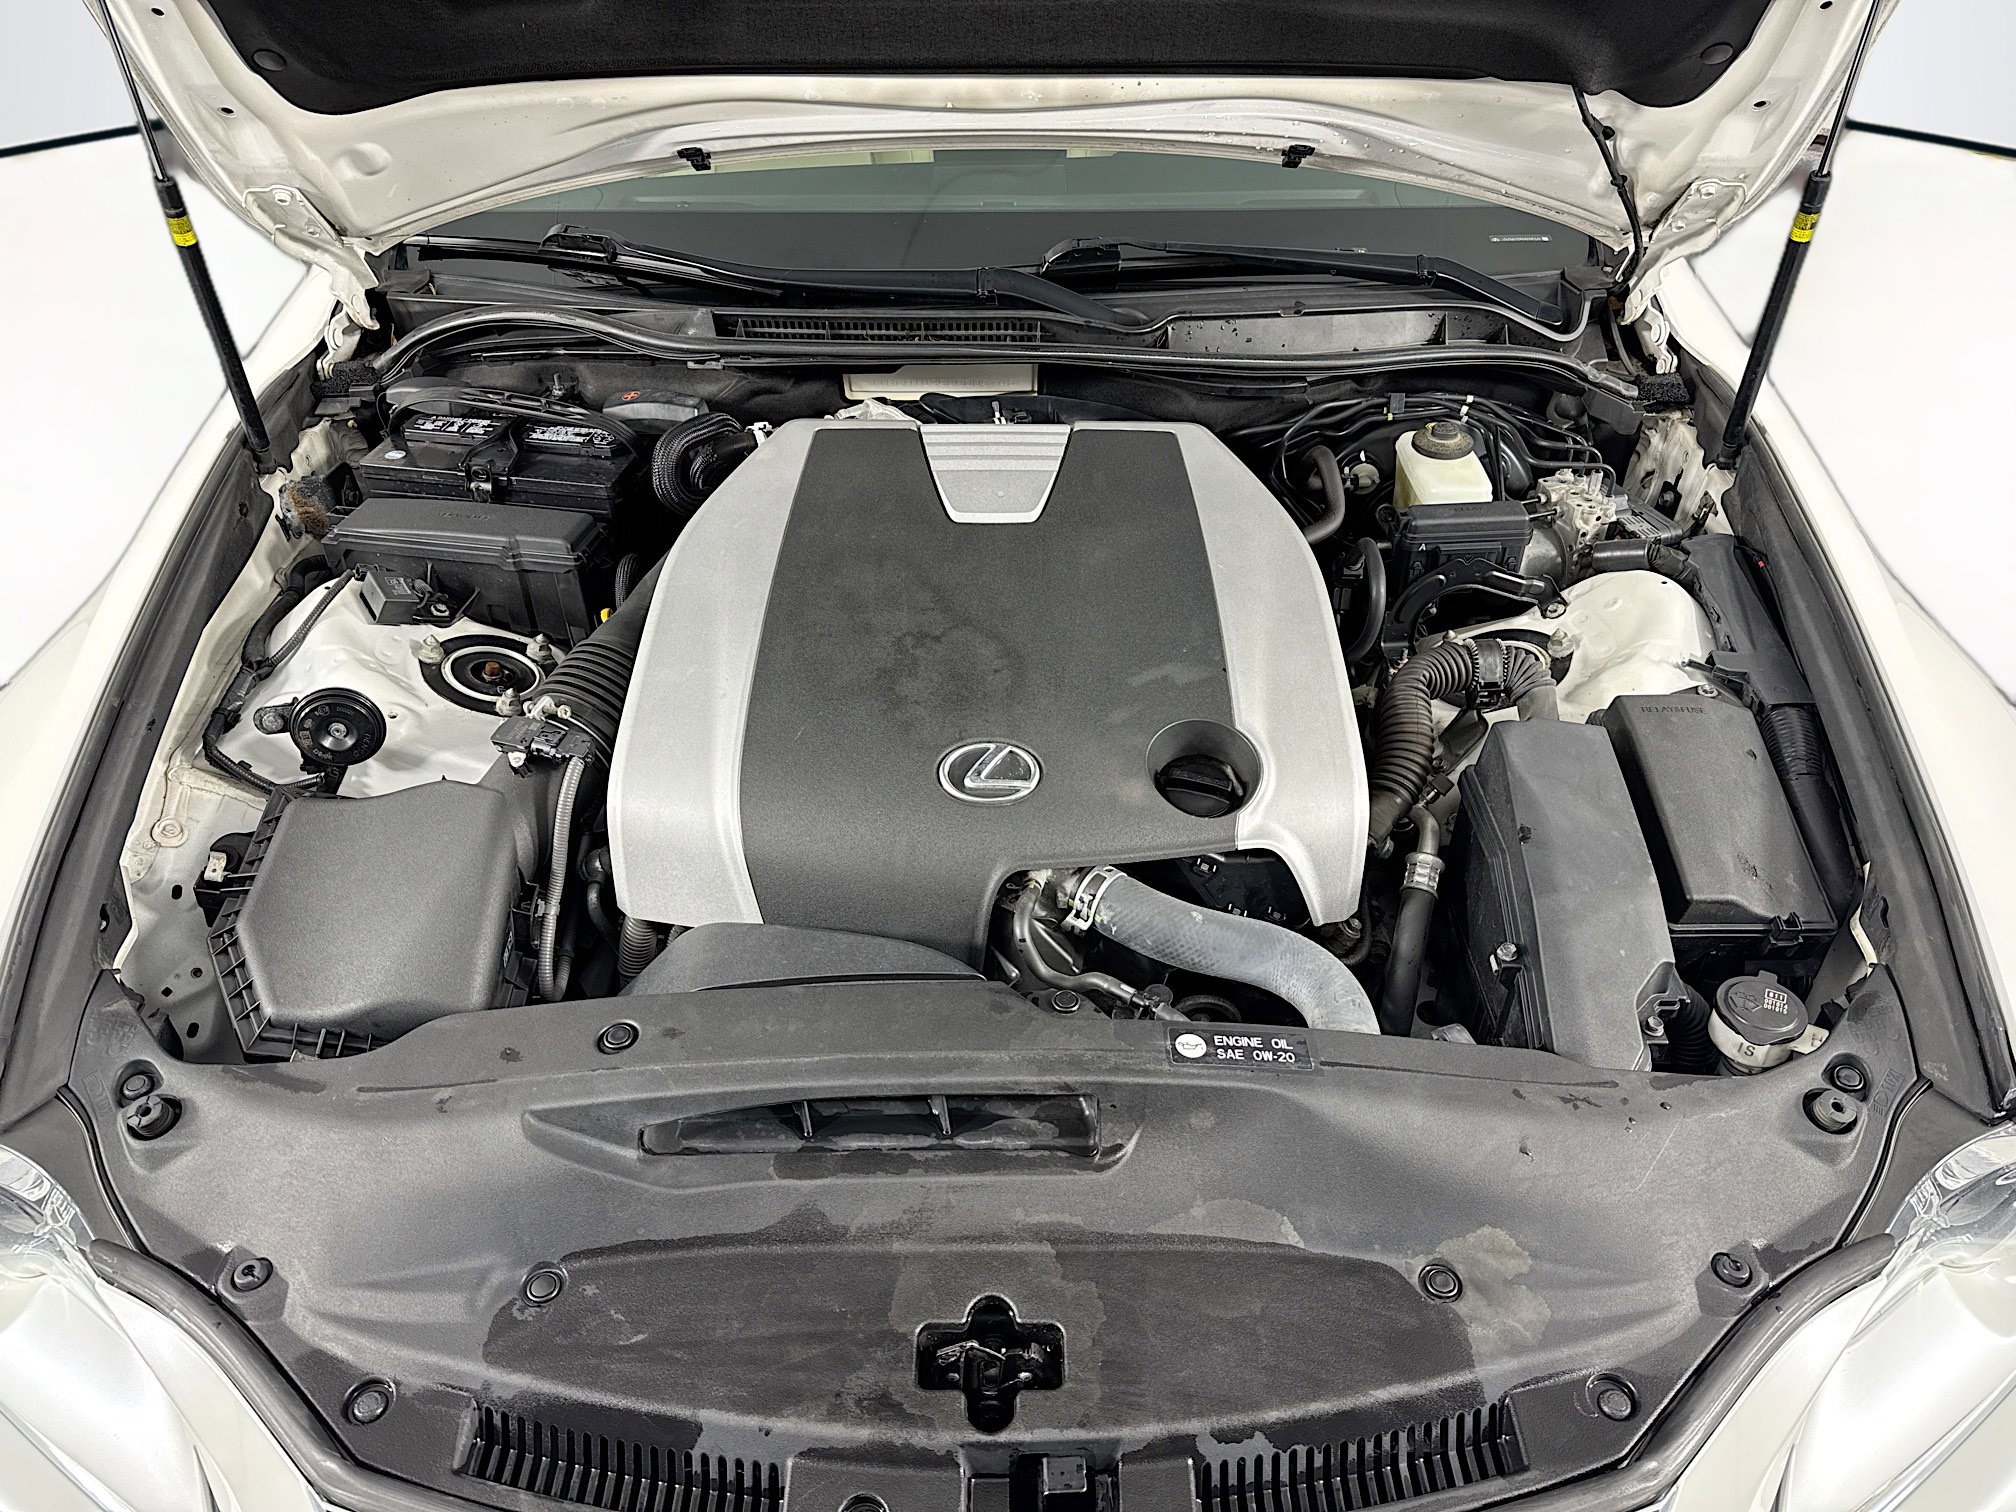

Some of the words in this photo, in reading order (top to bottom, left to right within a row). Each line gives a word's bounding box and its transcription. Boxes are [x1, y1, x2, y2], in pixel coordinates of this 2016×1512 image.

[1213, 1035, 1264, 1048] ENGINE
[1271, 1038, 1294, 1050] OIL
[1216, 1048, 1245, 1060] SAE
[1252, 1050, 1296, 1063] 0W-20
